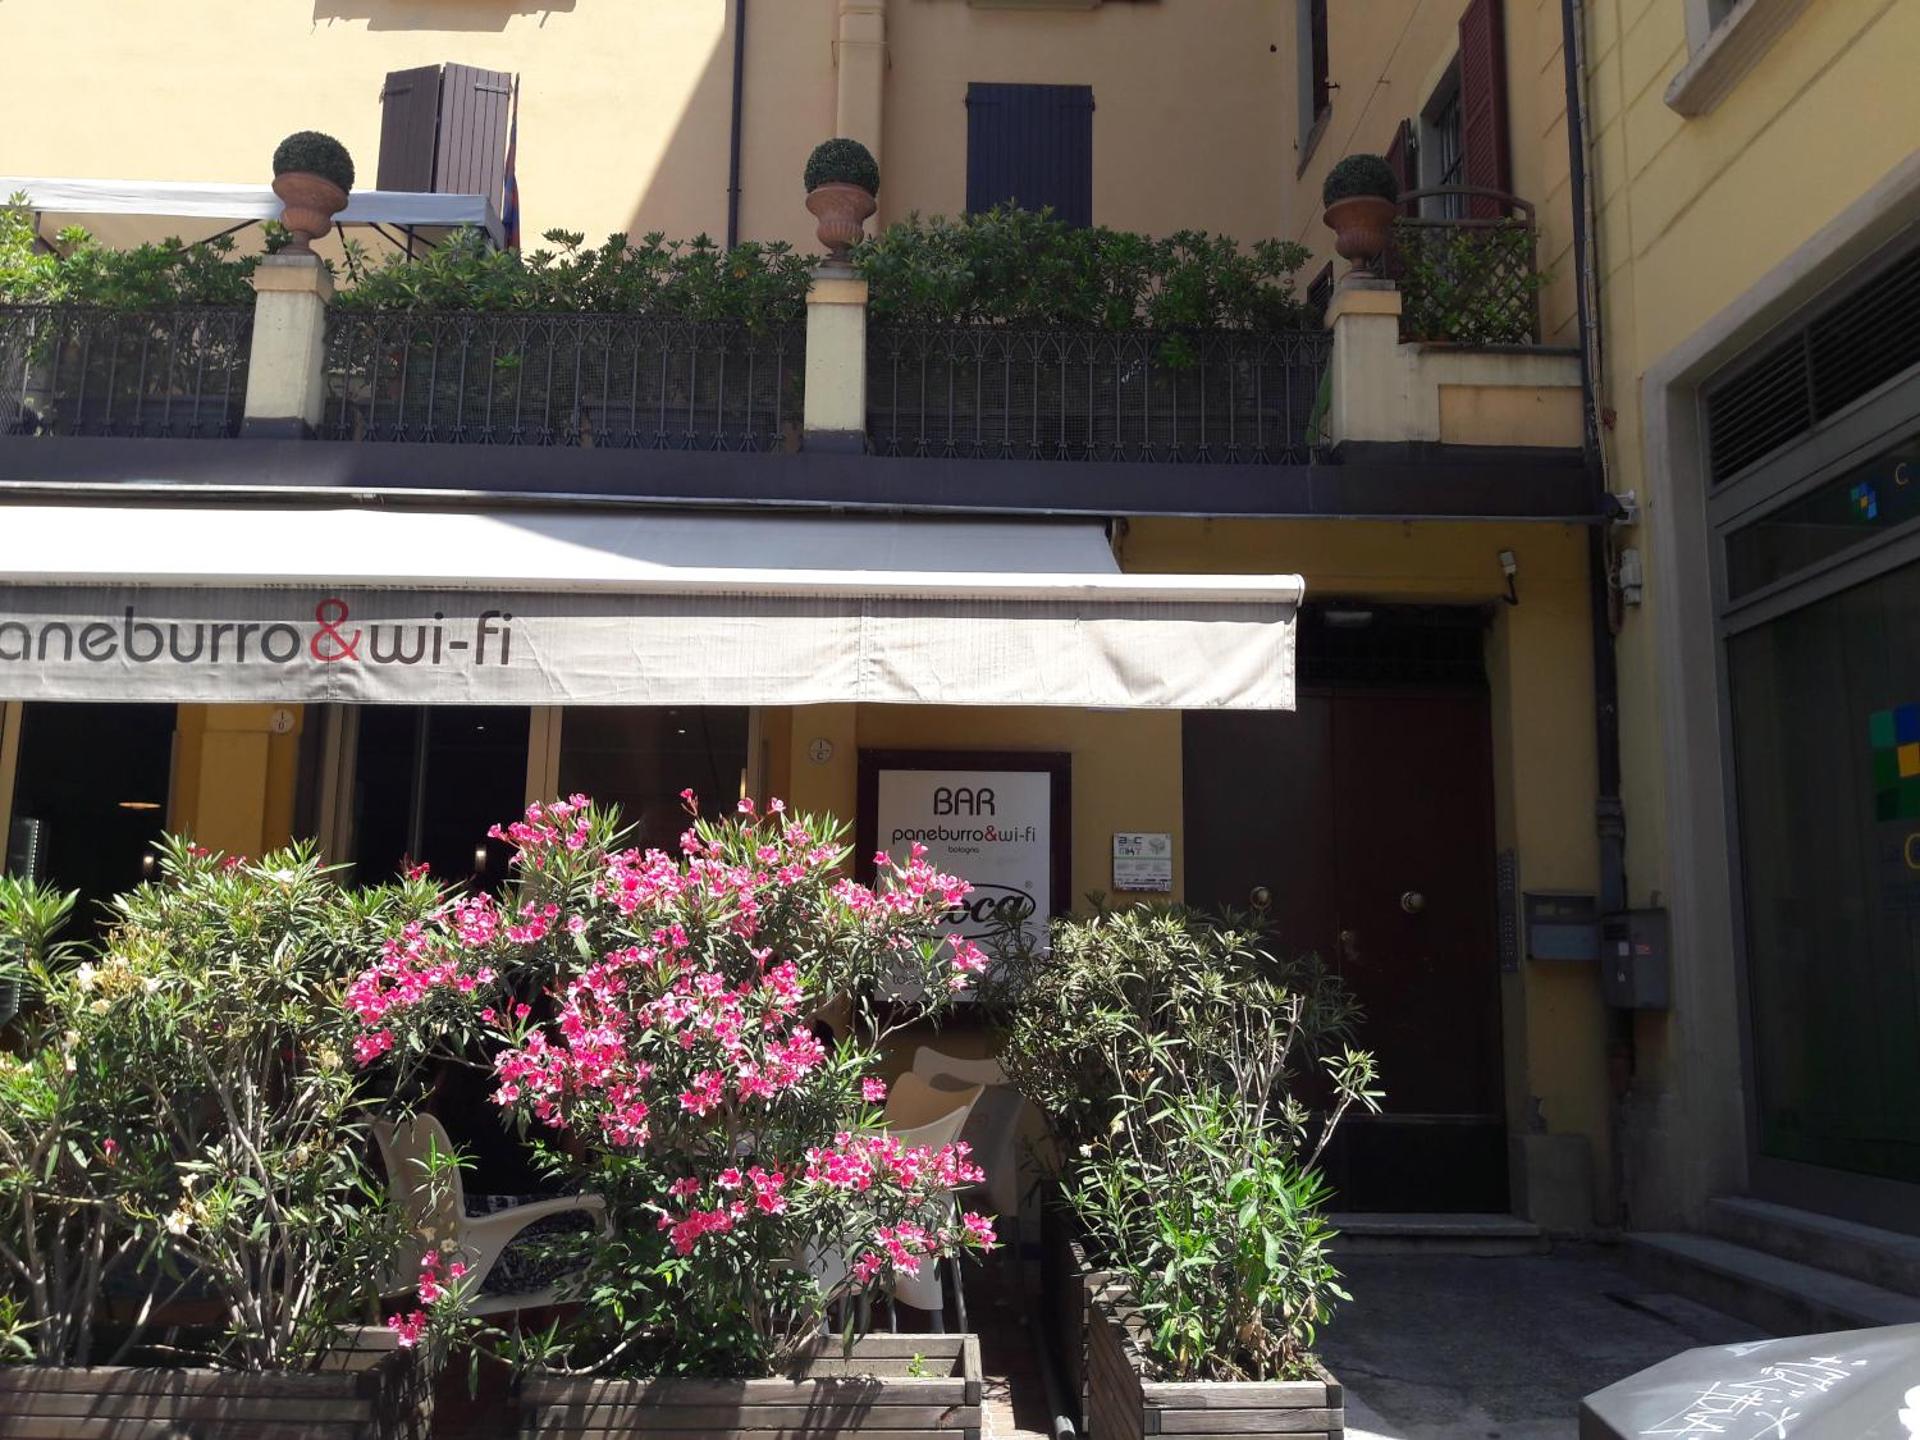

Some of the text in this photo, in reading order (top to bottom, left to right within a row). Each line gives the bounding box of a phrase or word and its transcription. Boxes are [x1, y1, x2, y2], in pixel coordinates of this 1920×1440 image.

[933, 786, 995, 816] BAR
[892, 825, 1036, 845] paneburro&wi-fi
[947, 845, 980, 855] bologna
